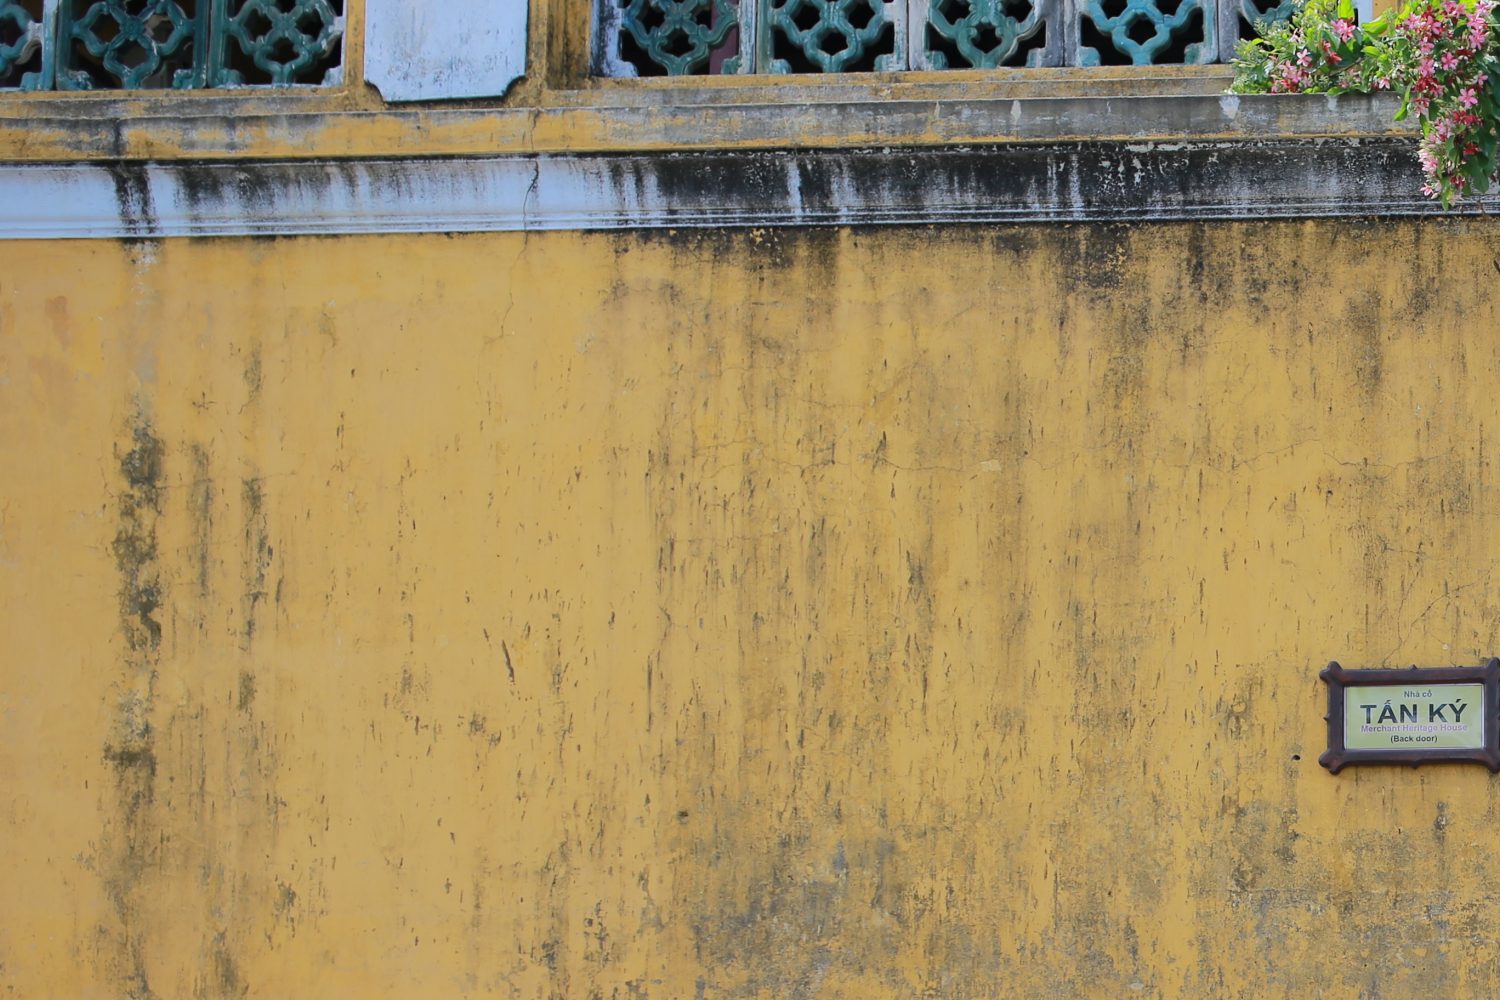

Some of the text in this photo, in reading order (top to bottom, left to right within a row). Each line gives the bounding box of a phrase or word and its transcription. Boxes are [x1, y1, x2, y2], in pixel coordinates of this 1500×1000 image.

[1403, 689, 1433, 698] Nhà cổ
[1360, 698, 1468, 724] TẤN KÝ
[1361, 723, 1468, 733] Merchant Heritage House
[1390, 734, 1438, 743] (Back door)
